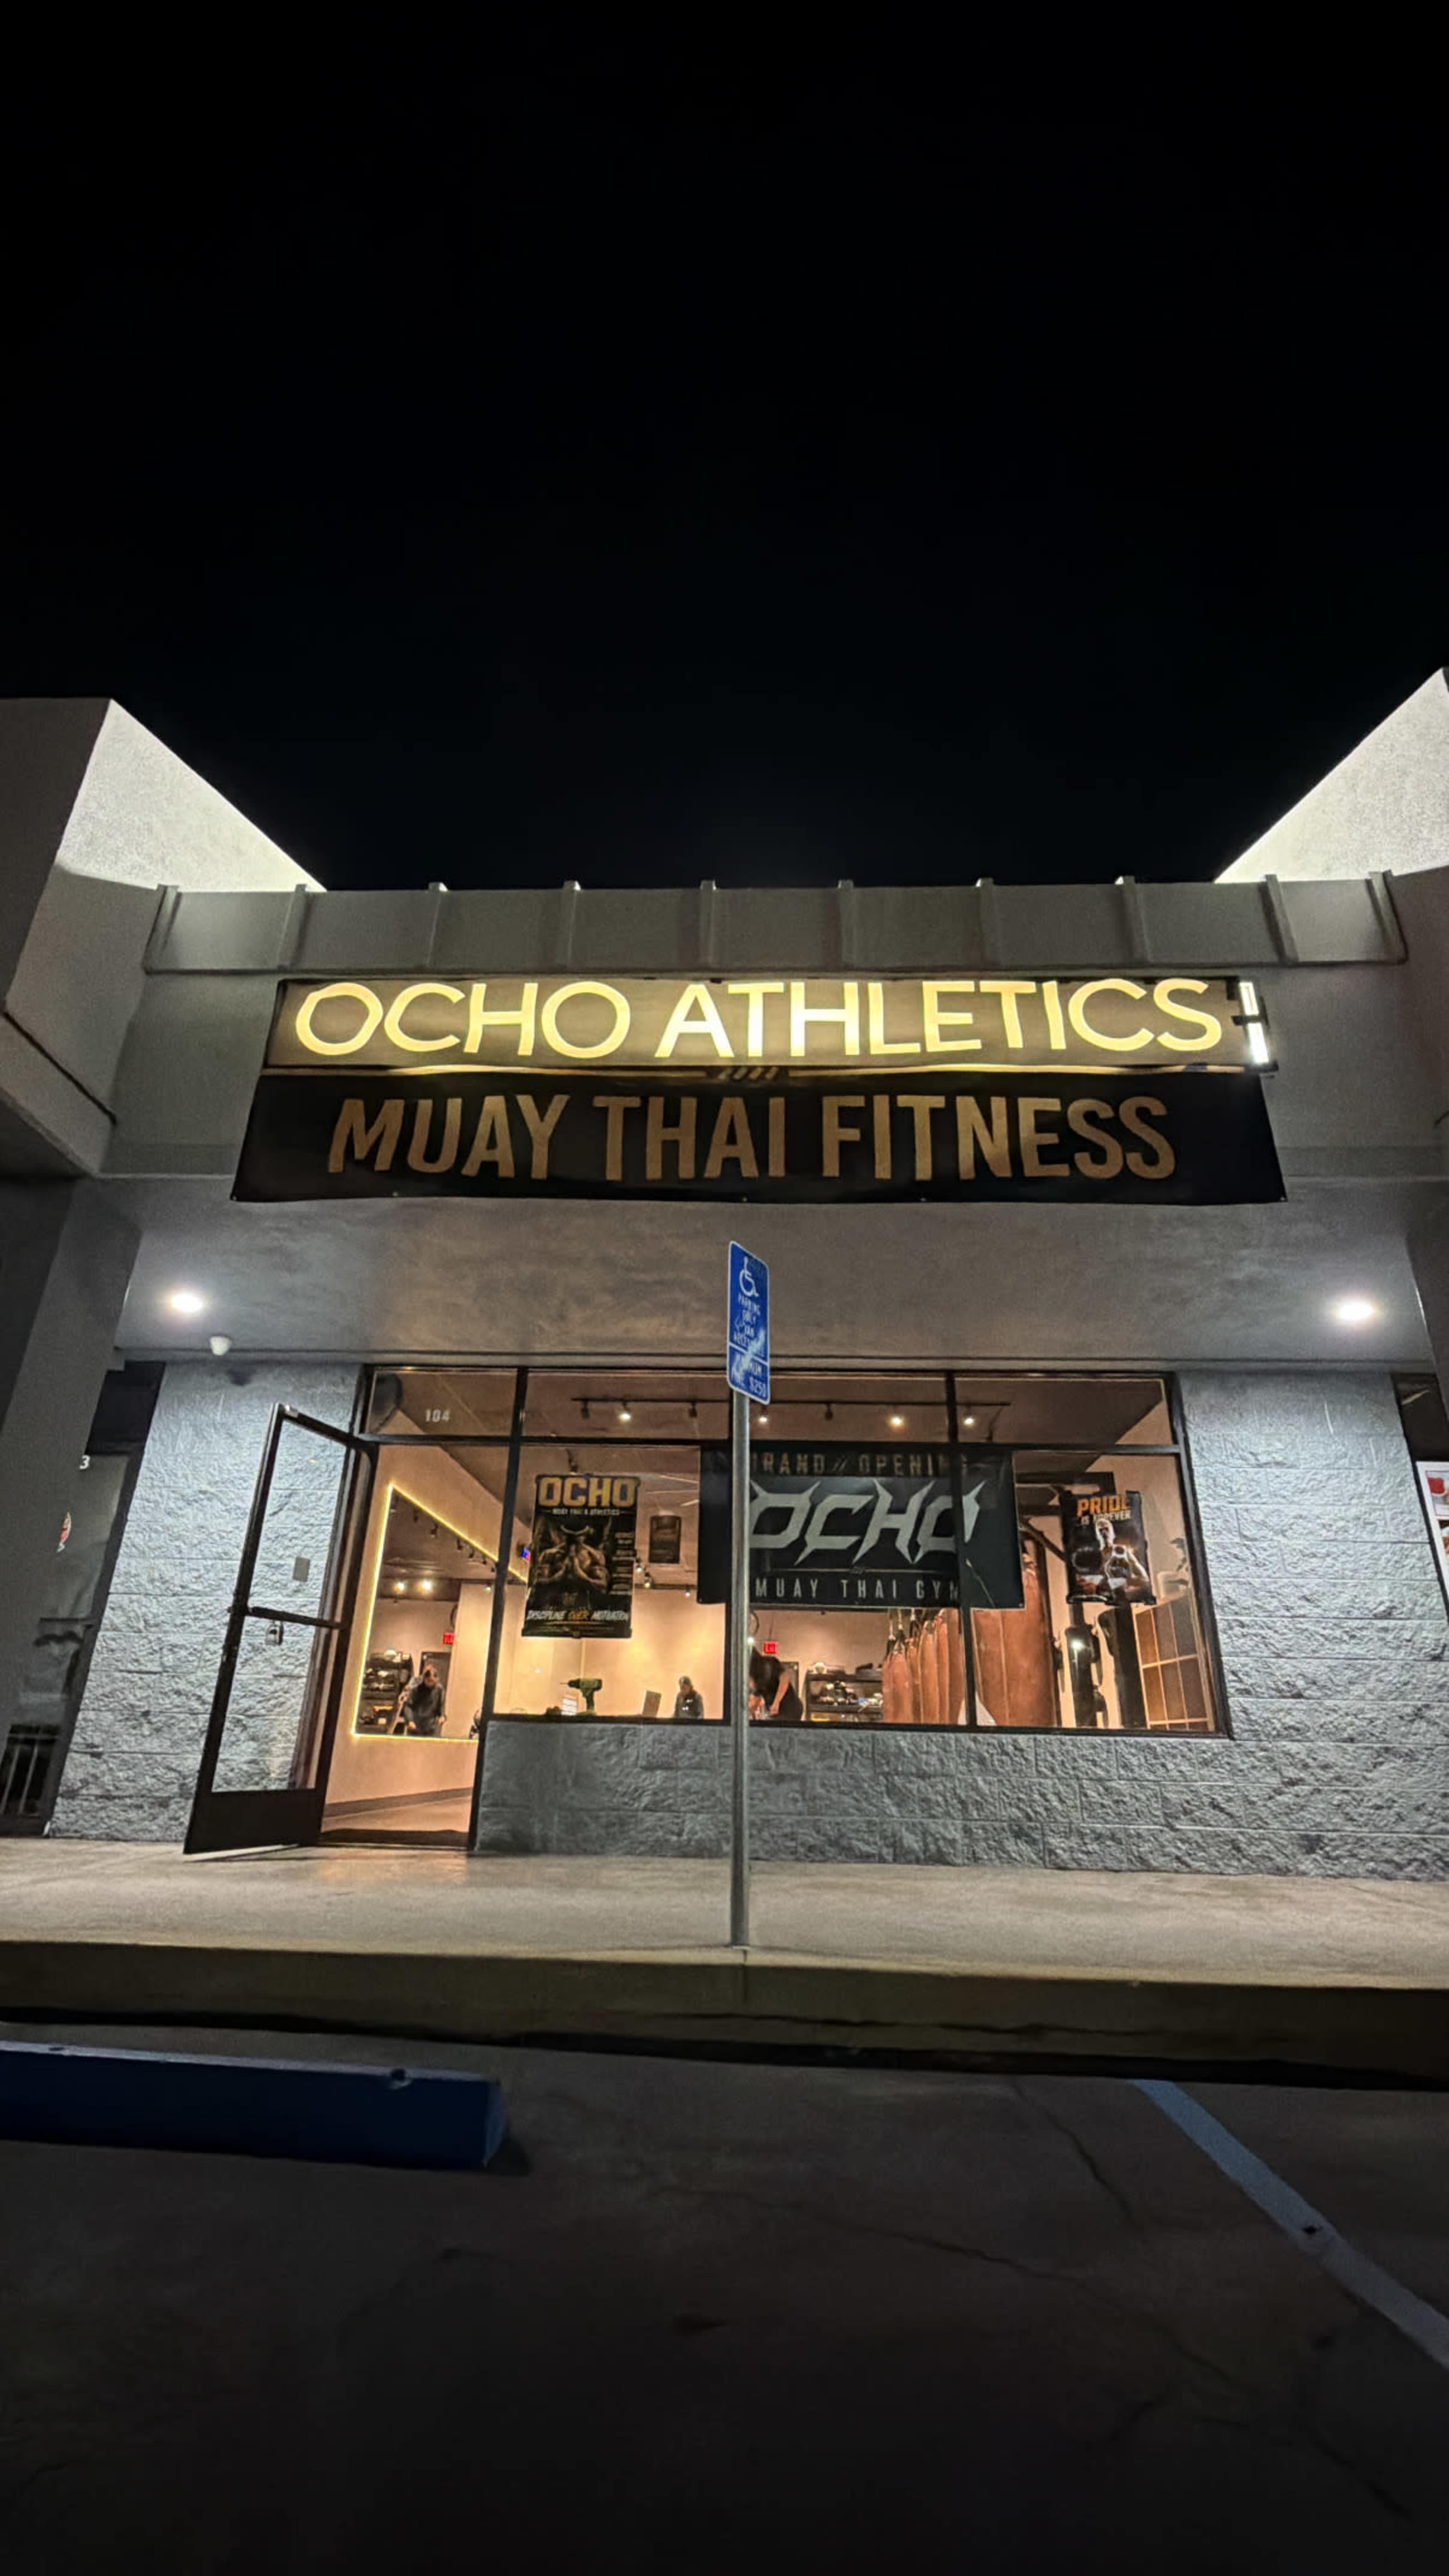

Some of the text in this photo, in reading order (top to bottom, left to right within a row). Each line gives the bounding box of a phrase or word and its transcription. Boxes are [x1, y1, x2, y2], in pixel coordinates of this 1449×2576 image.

[296, 978, 1222, 1058] OCHO ATHLETICS
[328, 1095, 1175, 1181] MUAY THAI FITNESS
[425, 1409, 450, 1422] 104
[538, 1477, 635, 1507] OCHO
[750, 1479, 986, 1564] OCHO
[756, 1578, 818, 1598] MUAY
[841, 1579, 897, 1599] THAI
